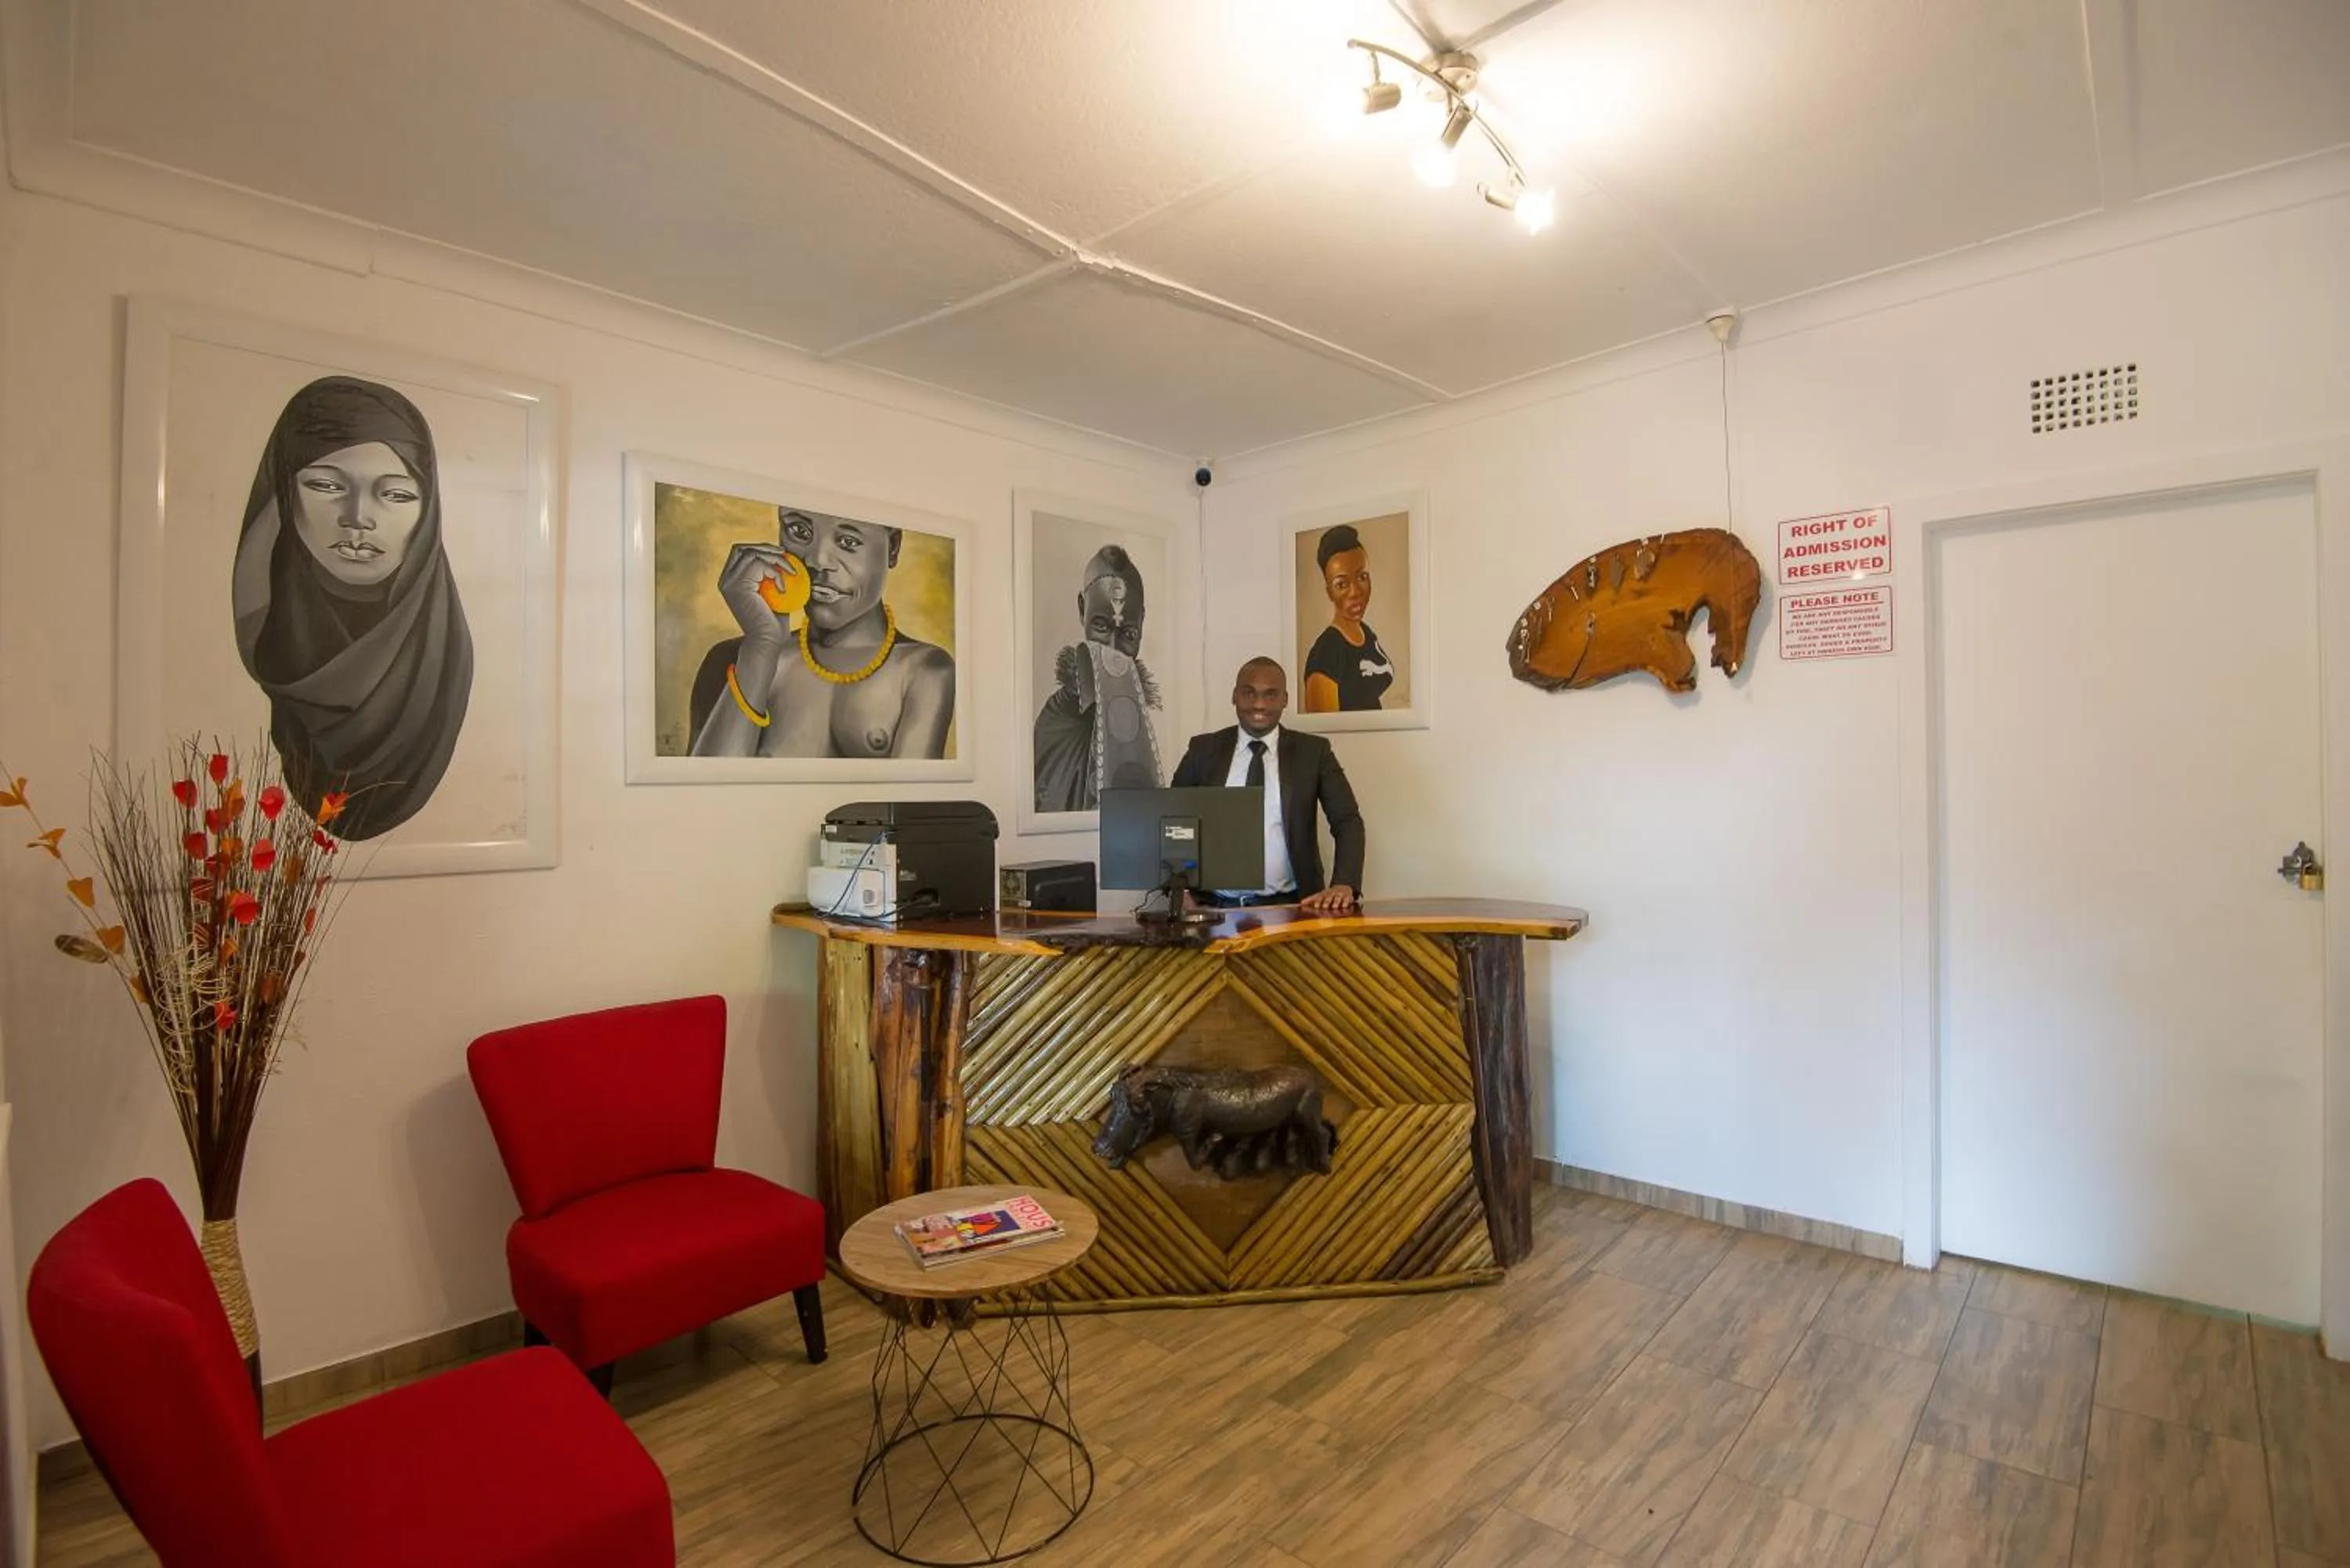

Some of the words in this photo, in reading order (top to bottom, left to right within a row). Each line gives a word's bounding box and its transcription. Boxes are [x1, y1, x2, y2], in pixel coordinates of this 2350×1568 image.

[1791, 519, 1847, 537] RIGHT
[1853, 515, 1878, 529] OF
[1784, 534, 1886, 558] ADMISSION
[1787, 556, 1884, 578] RESERVED
[1791, 596, 1838, 608] PLEASE
[1843, 592, 1879, 603] NOTE
